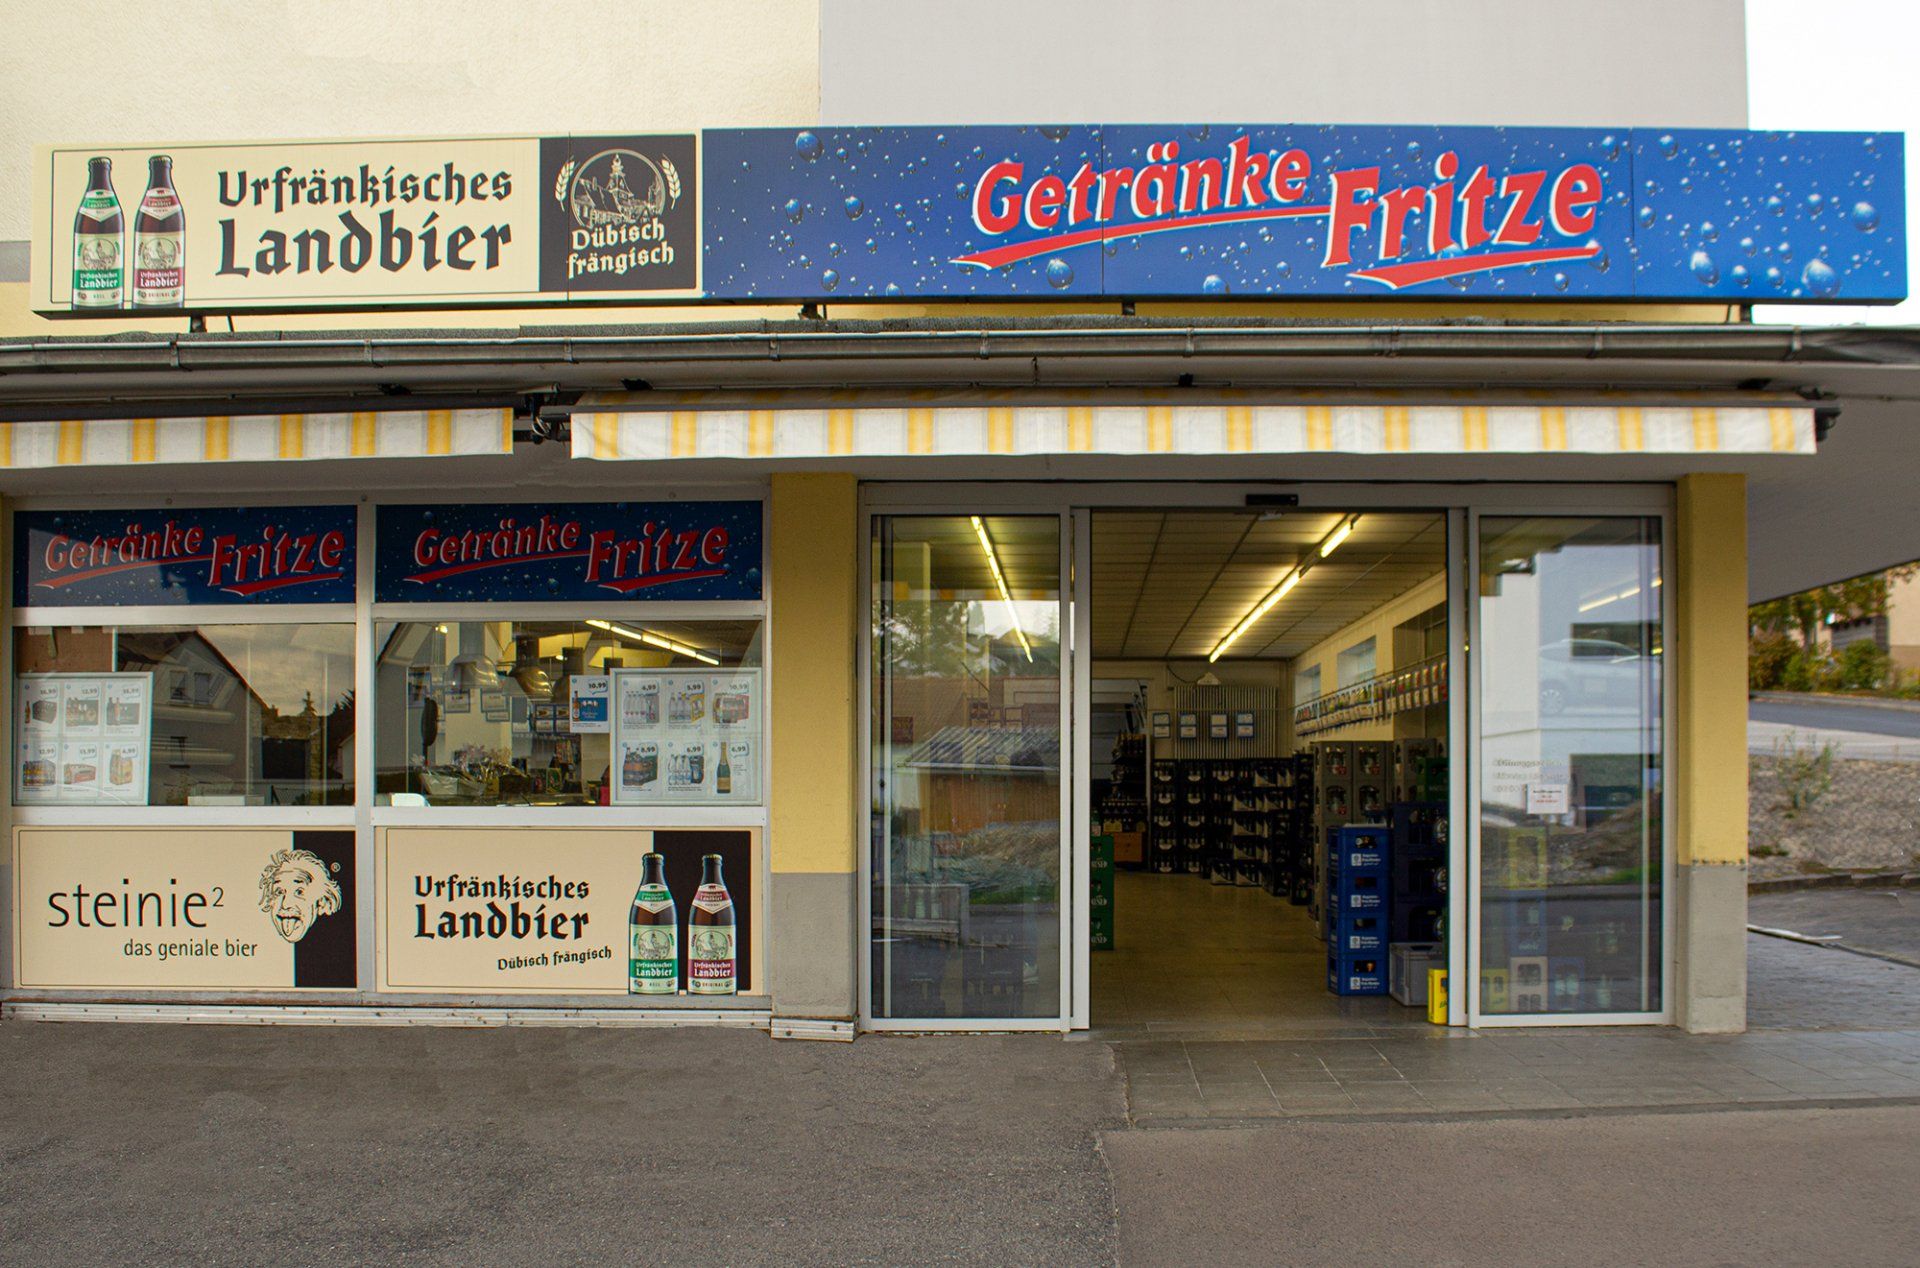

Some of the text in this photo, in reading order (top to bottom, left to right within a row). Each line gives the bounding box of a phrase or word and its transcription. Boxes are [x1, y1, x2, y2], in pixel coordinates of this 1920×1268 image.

[217, 162, 513, 213] Urfränkisches
[972, 135, 1602, 267] Getränke Fritze
[214, 209, 513, 278] Landbier
[571, 217, 666, 251] Dübisch
[568, 240, 675, 280] frängisch
[80, 278, 118, 289] Landbier
[140, 277, 179, 287] Landbier
[45, 520, 347, 587] Getränke Fritze
[413, 514, 730, 582] Getränke Fritze
[414, 873, 590, 902] Urfränkisches
[414, 901, 590, 940] Landbier
[124, 938, 258, 961] das geniale bier
[497, 945, 612, 971] Dübisch frängisch
[636, 968, 673, 977] Landbier
[694, 968, 731, 977] Landbier
